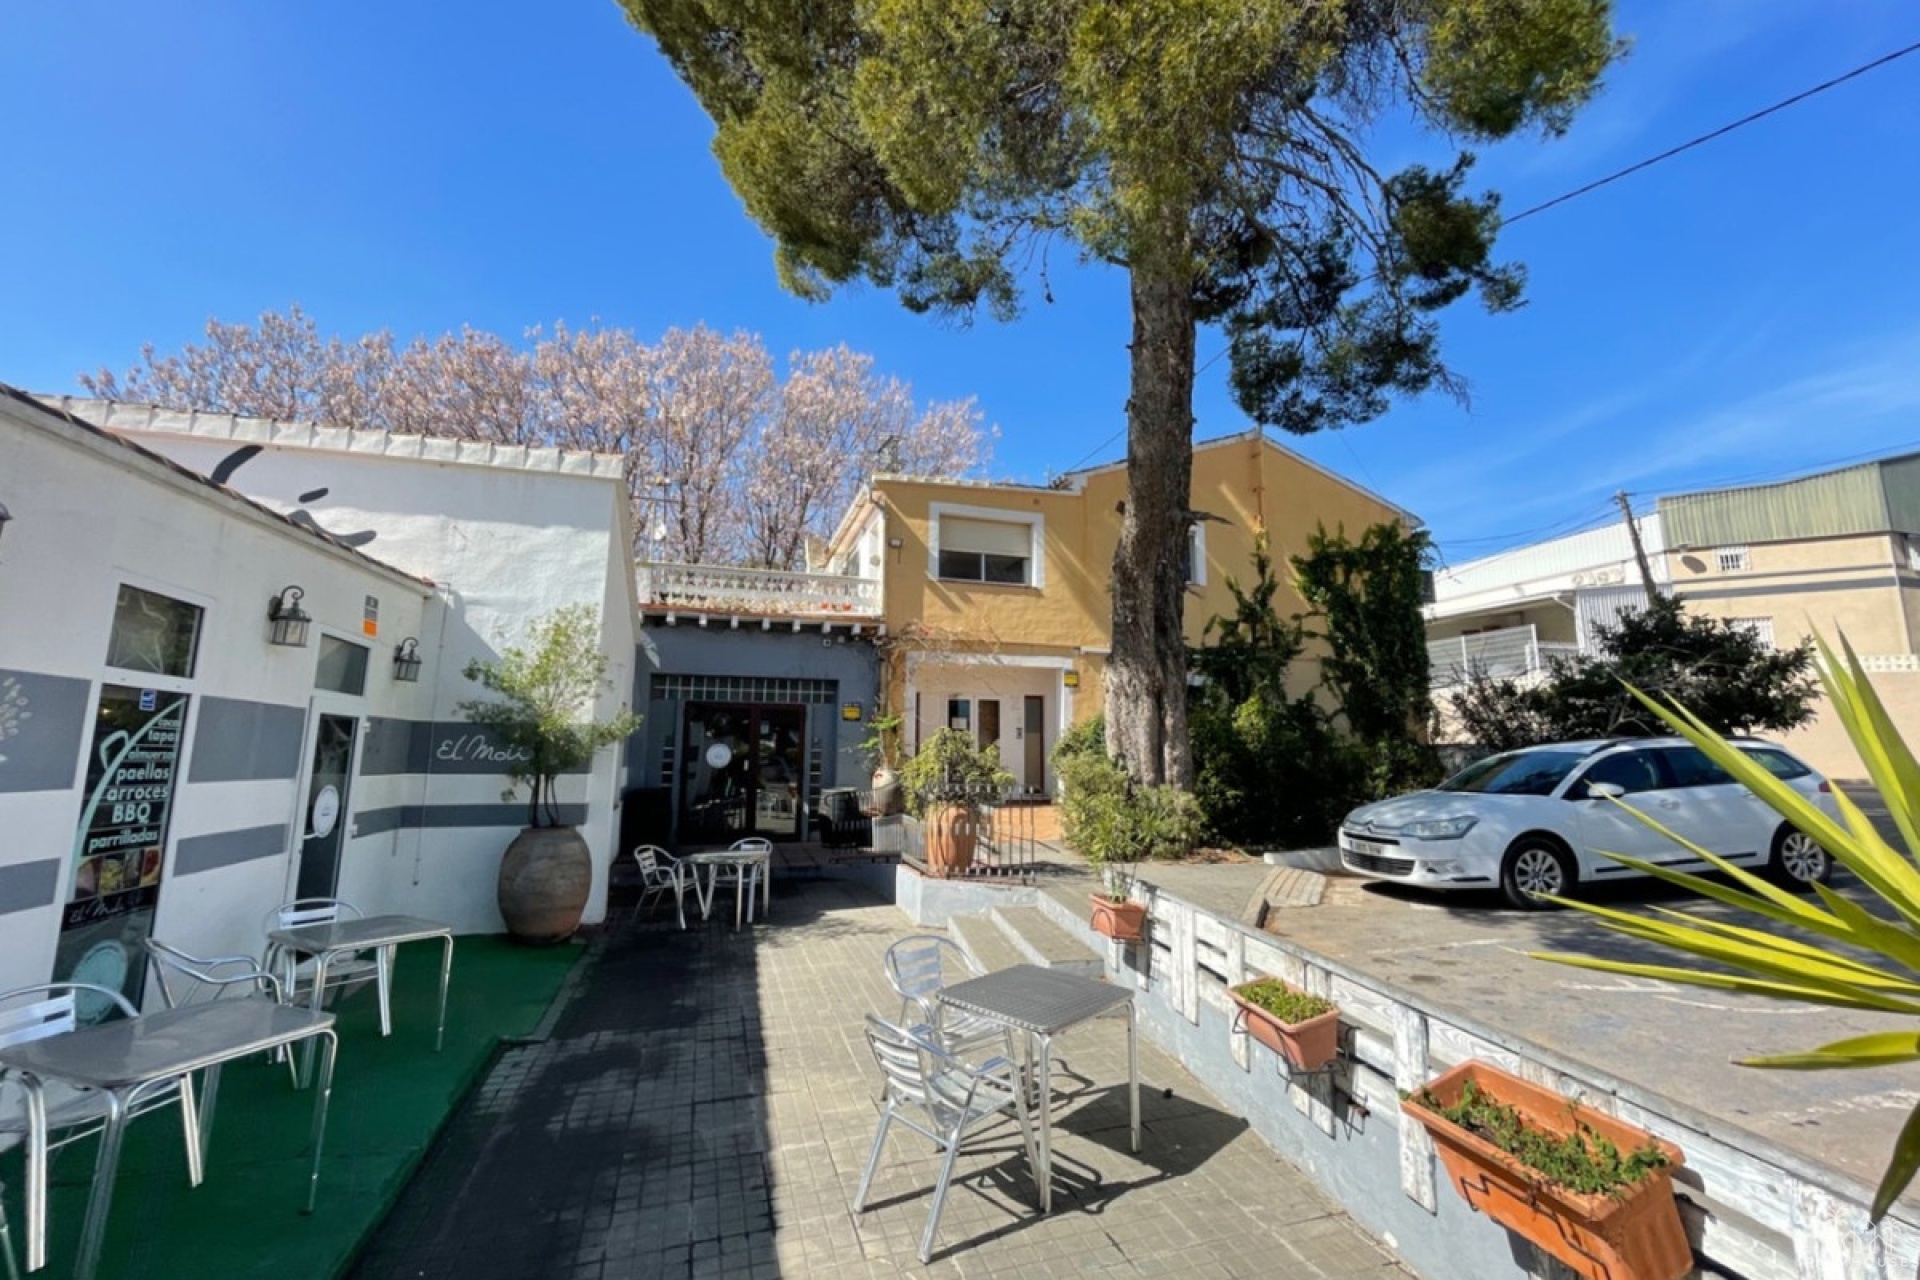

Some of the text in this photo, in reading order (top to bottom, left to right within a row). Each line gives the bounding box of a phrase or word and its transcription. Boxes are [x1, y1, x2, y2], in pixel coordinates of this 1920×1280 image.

[436, 734, 468, 761] El
[115, 761, 170, 786] paellas
[106, 785, 169, 801] arroces
[111, 802, 151, 825] BBQ
[88, 826, 158, 854] parrilladas
